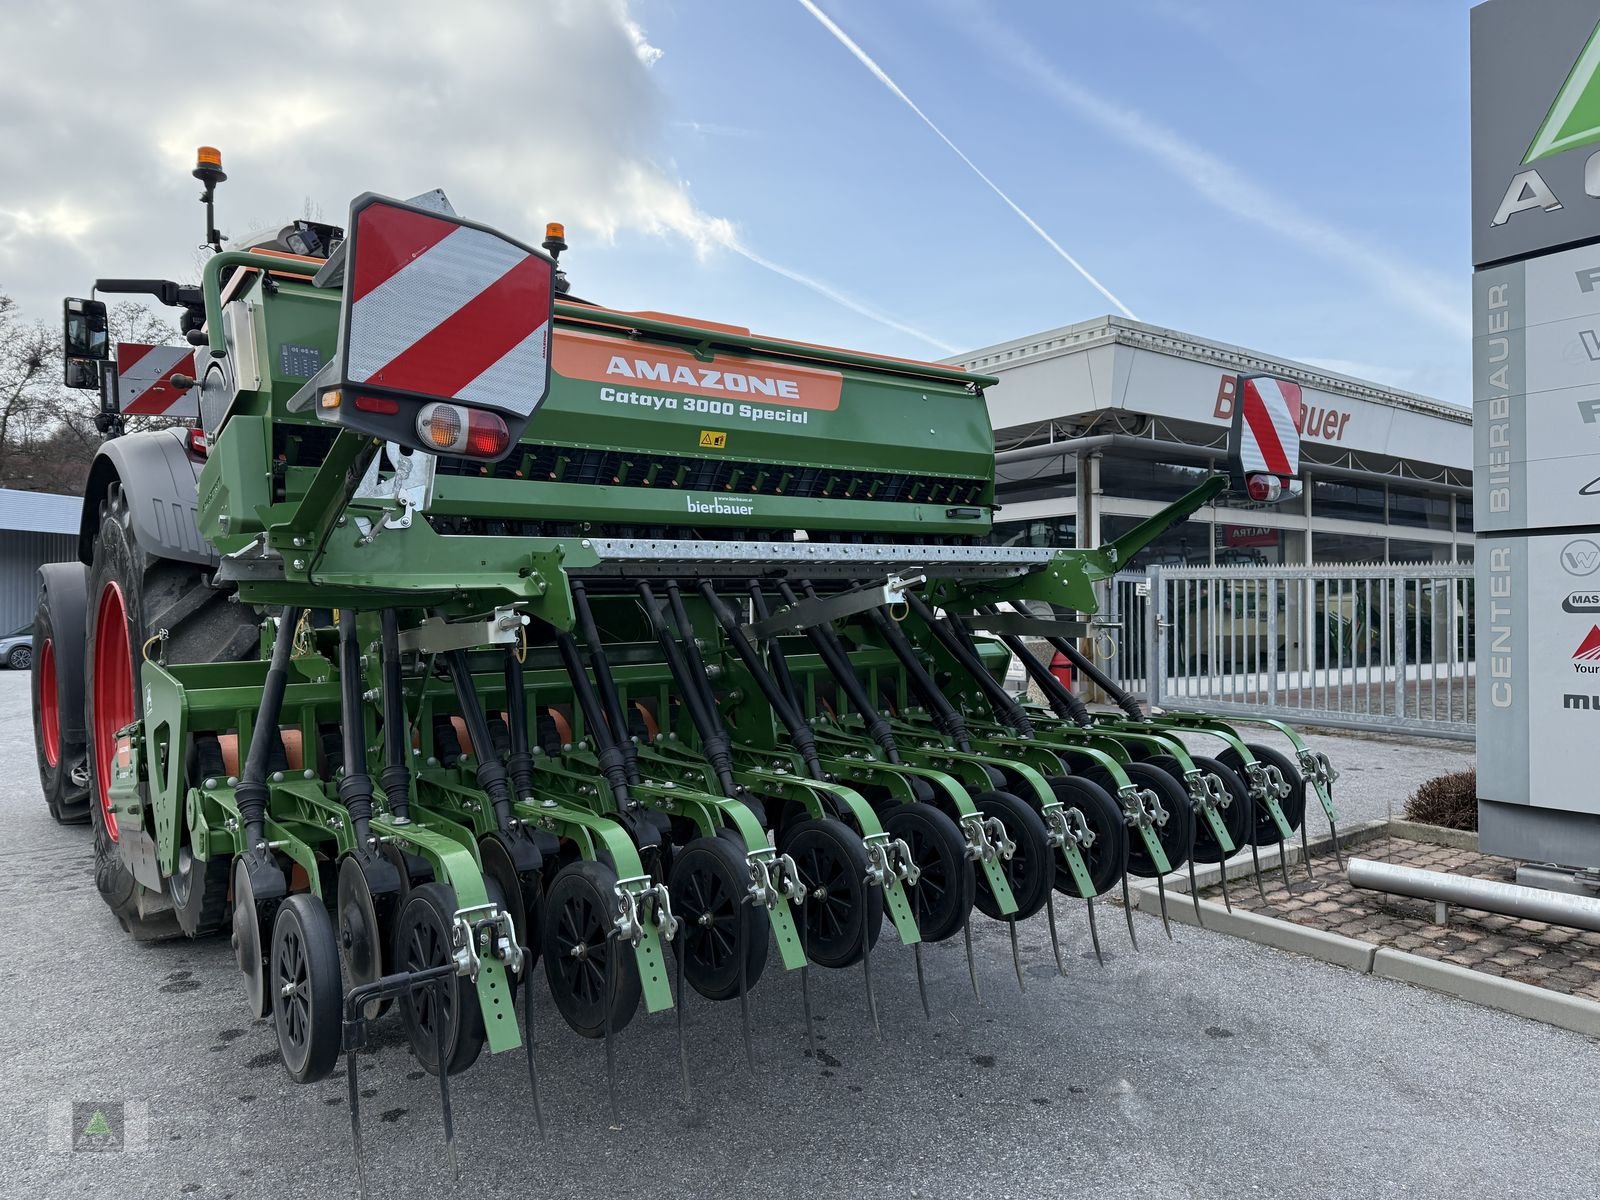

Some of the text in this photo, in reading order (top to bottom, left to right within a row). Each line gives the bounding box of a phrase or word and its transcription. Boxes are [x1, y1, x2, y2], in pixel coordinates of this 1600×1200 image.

[606, 355, 800, 399] AMAZONE
[600, 387, 808, 424] Cataya 3000 Special
[1488, 283, 1511, 513] BIERBAUER
[687, 495, 754, 515] bierbauer
[1572, 595, 1600, 604] MAS
[1489, 546, 1513, 709] CENTER
[1574, 663, 1600, 674] Your
